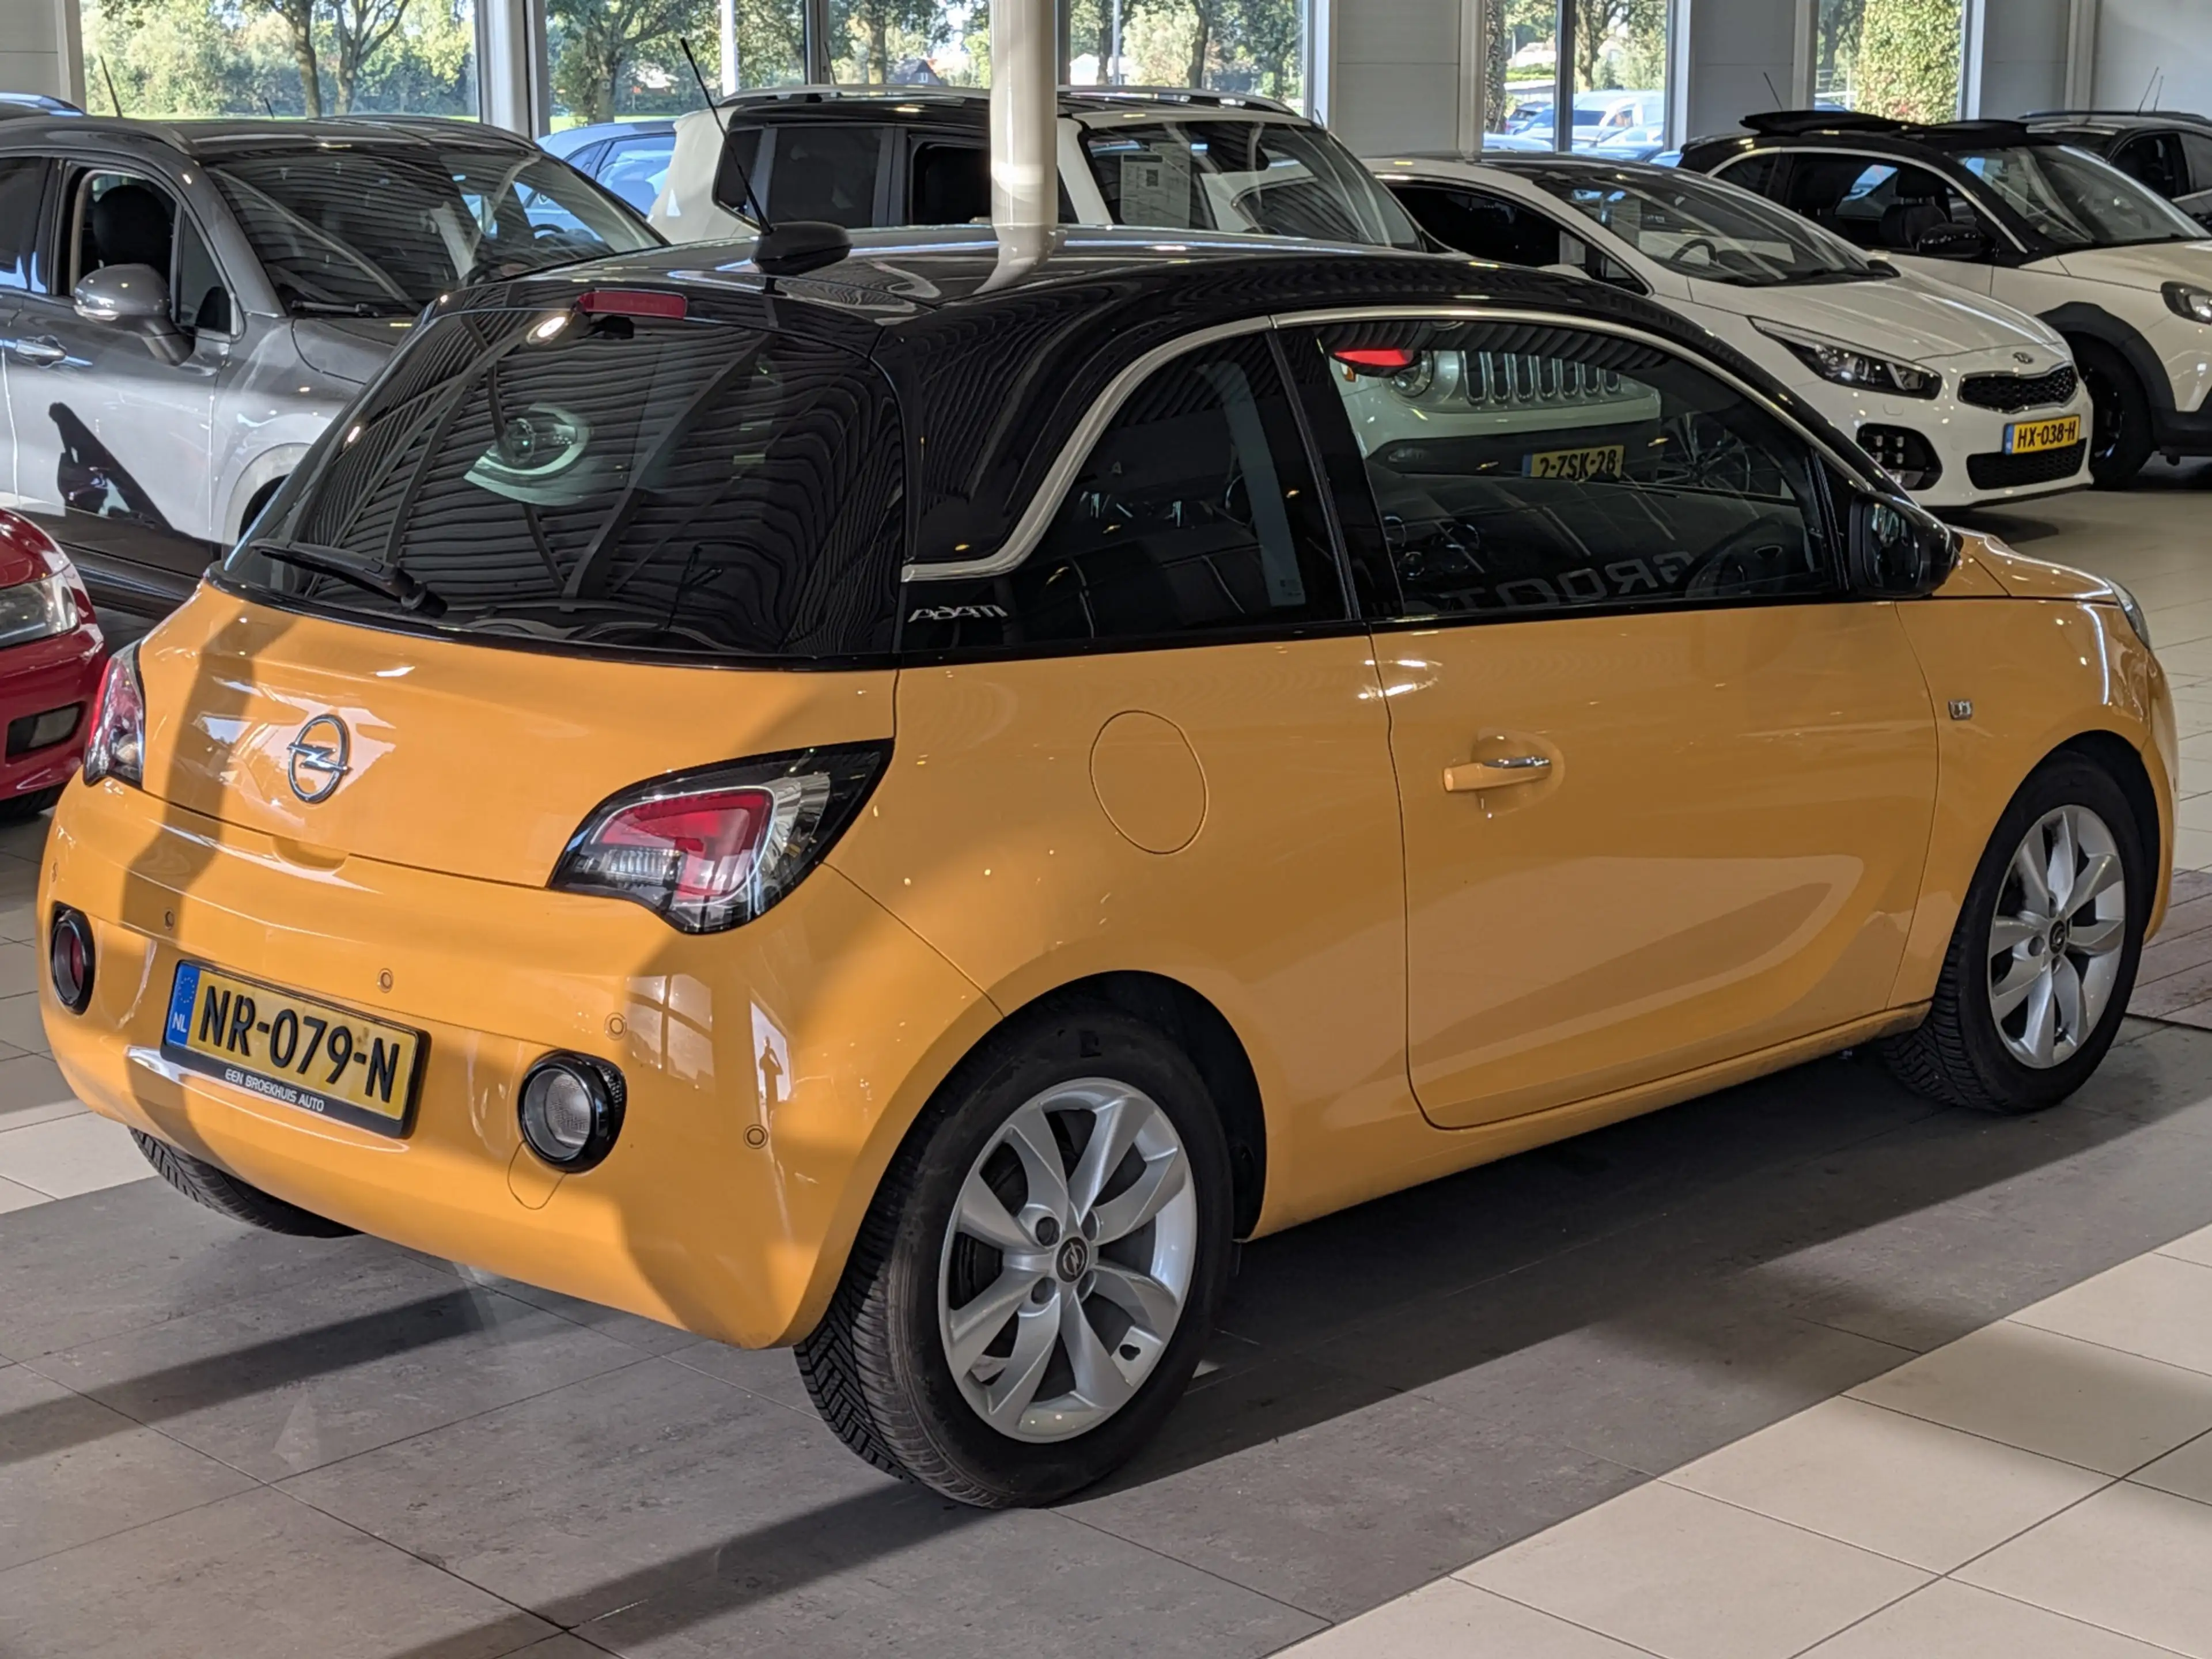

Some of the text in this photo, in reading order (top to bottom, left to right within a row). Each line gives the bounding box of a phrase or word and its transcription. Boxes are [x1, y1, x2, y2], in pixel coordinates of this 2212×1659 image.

[2017, 420, 2076, 449] HX-038-H
[172, 1010, 188, 1033] NL
[198, 985, 400, 1104] NR-079-N
[225, 1068, 324, 1112] EEN BROEKHUIS AUTO
